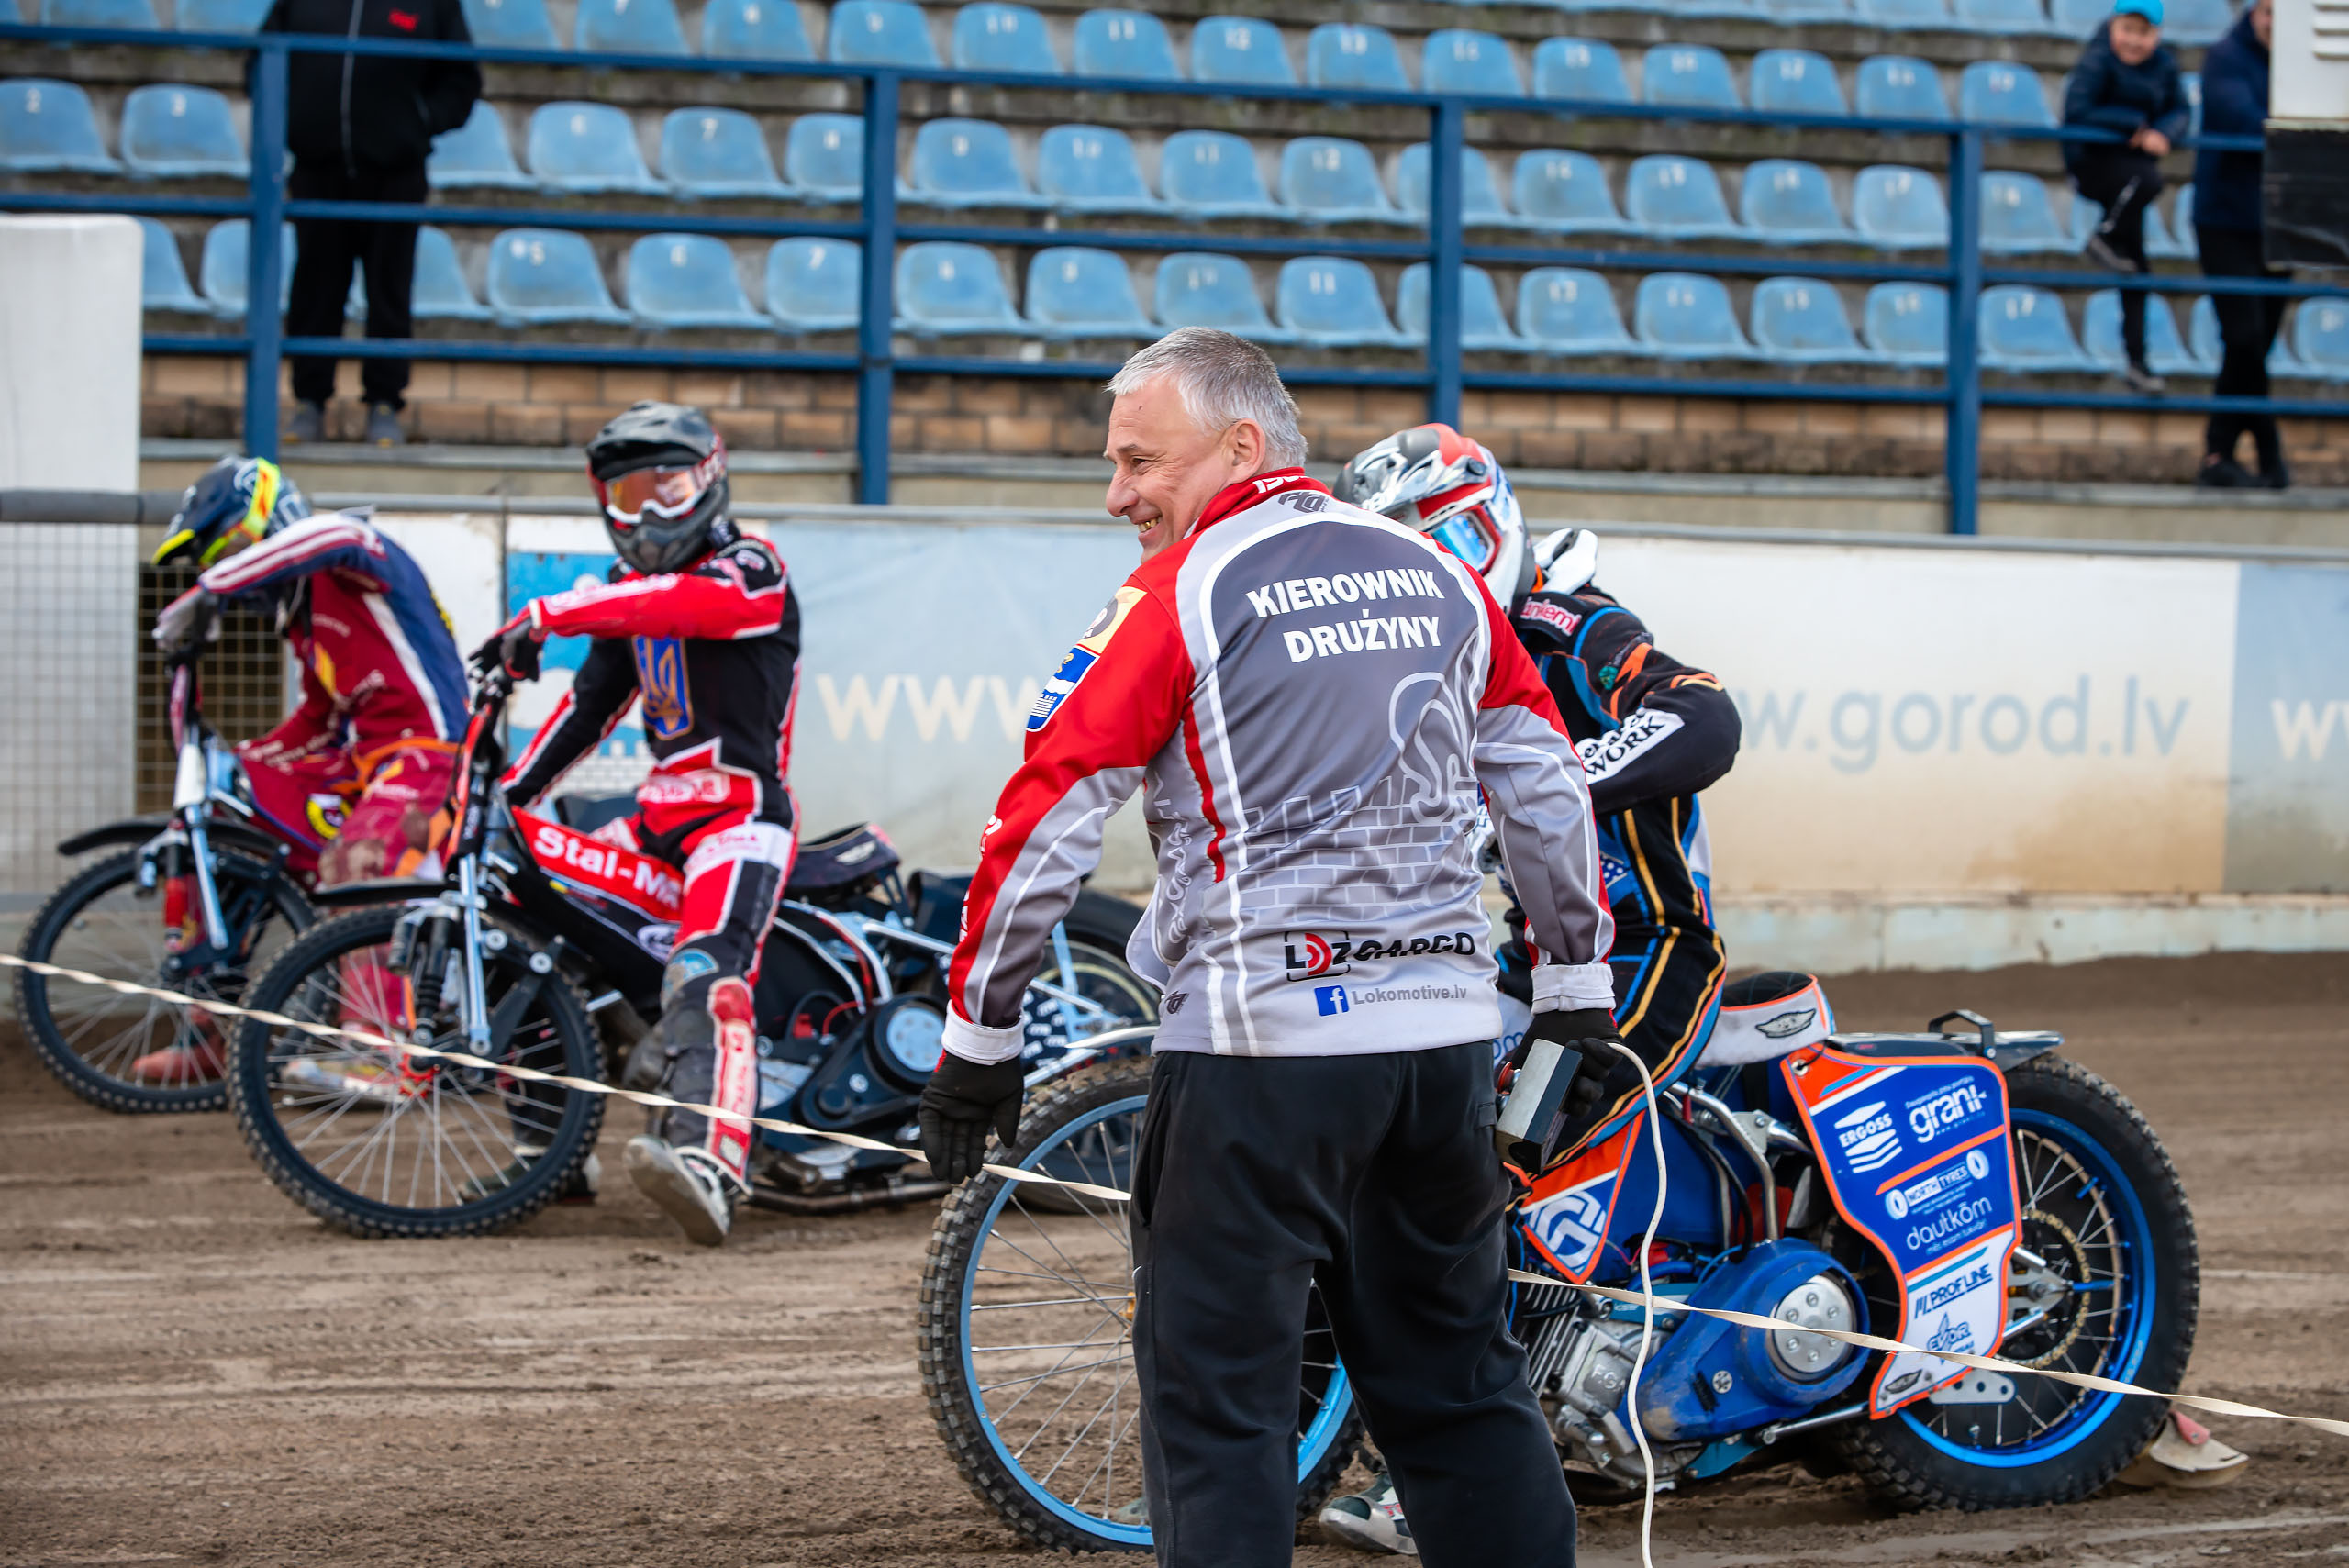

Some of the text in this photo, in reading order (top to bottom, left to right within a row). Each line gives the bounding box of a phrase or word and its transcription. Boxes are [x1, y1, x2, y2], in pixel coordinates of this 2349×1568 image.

[1245, 568, 1445, 618] KIEROWNIK
[1283, 608, 1442, 663] DRUŻYNY
[1586, 716, 1666, 775] WORK
[1352, 984, 1467, 1006] Lokomotive.lv
[1838, 1113, 1893, 1148] ERGOSS
[1929, 1262, 1992, 1306] PROFLINE
